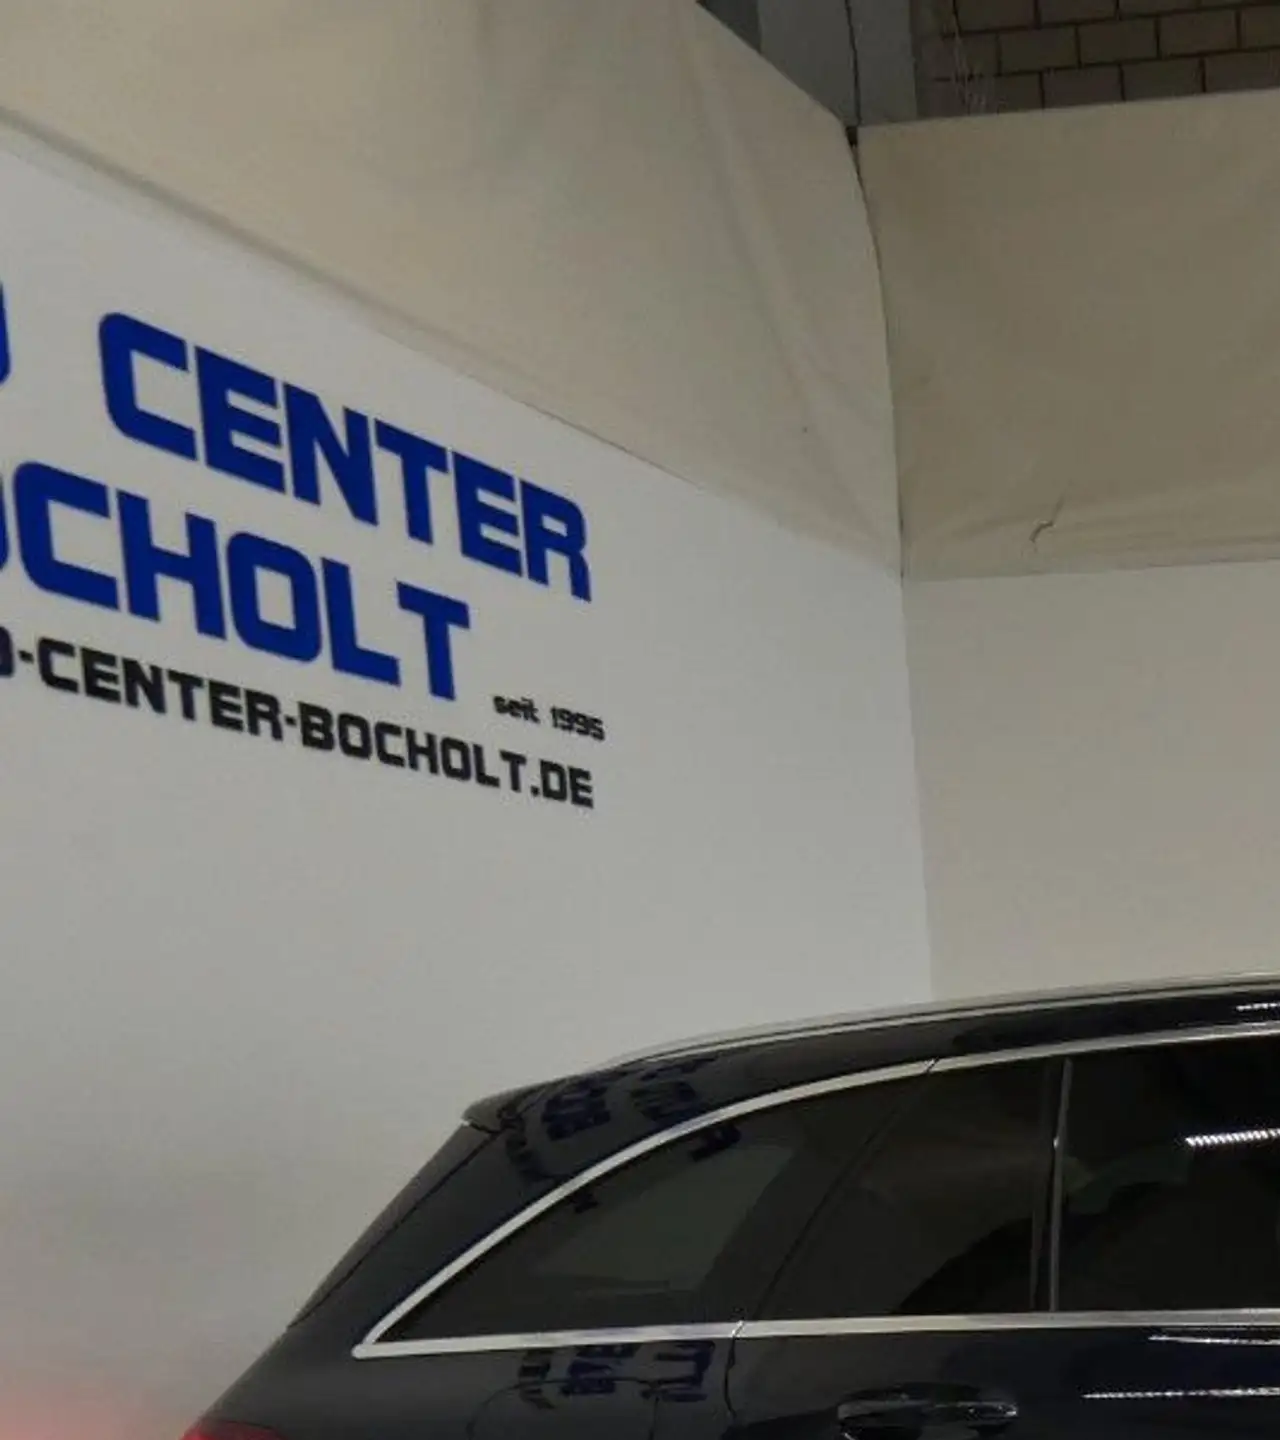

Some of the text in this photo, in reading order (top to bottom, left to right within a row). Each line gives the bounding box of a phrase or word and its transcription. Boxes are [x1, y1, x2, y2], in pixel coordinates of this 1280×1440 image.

[99, 311, 592, 603] CENTER
[0, 462, 471, 701] CHOLT
[493, 695, 606, 742] seit 1995
